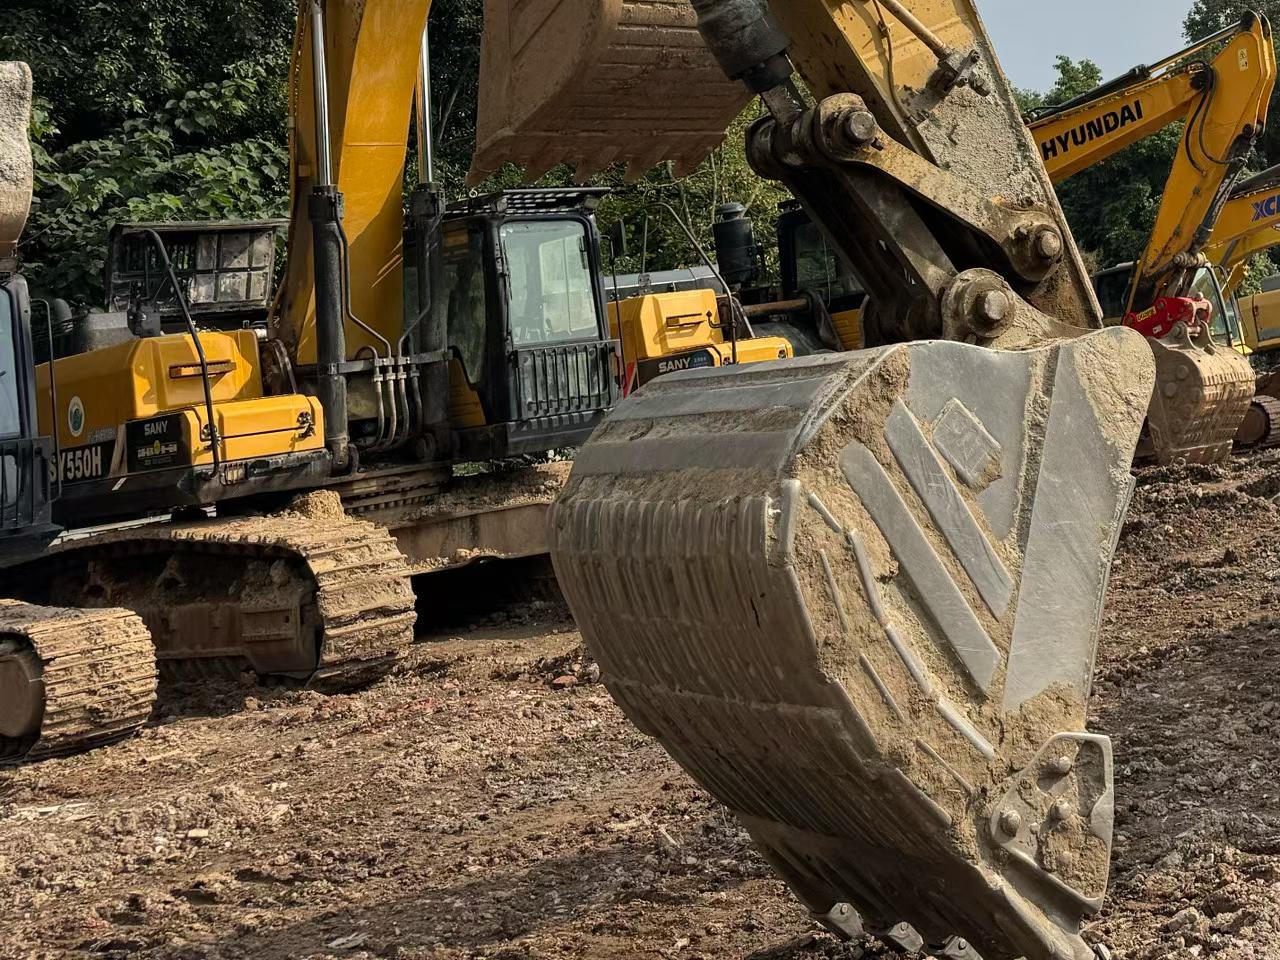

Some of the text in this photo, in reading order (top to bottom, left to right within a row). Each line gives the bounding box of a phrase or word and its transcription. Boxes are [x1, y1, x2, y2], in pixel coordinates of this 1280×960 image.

[1041, 99, 1144, 161] HYUNDAI
[658, 357, 691, 374] SANY
[144, 420, 169, 437] SANY
